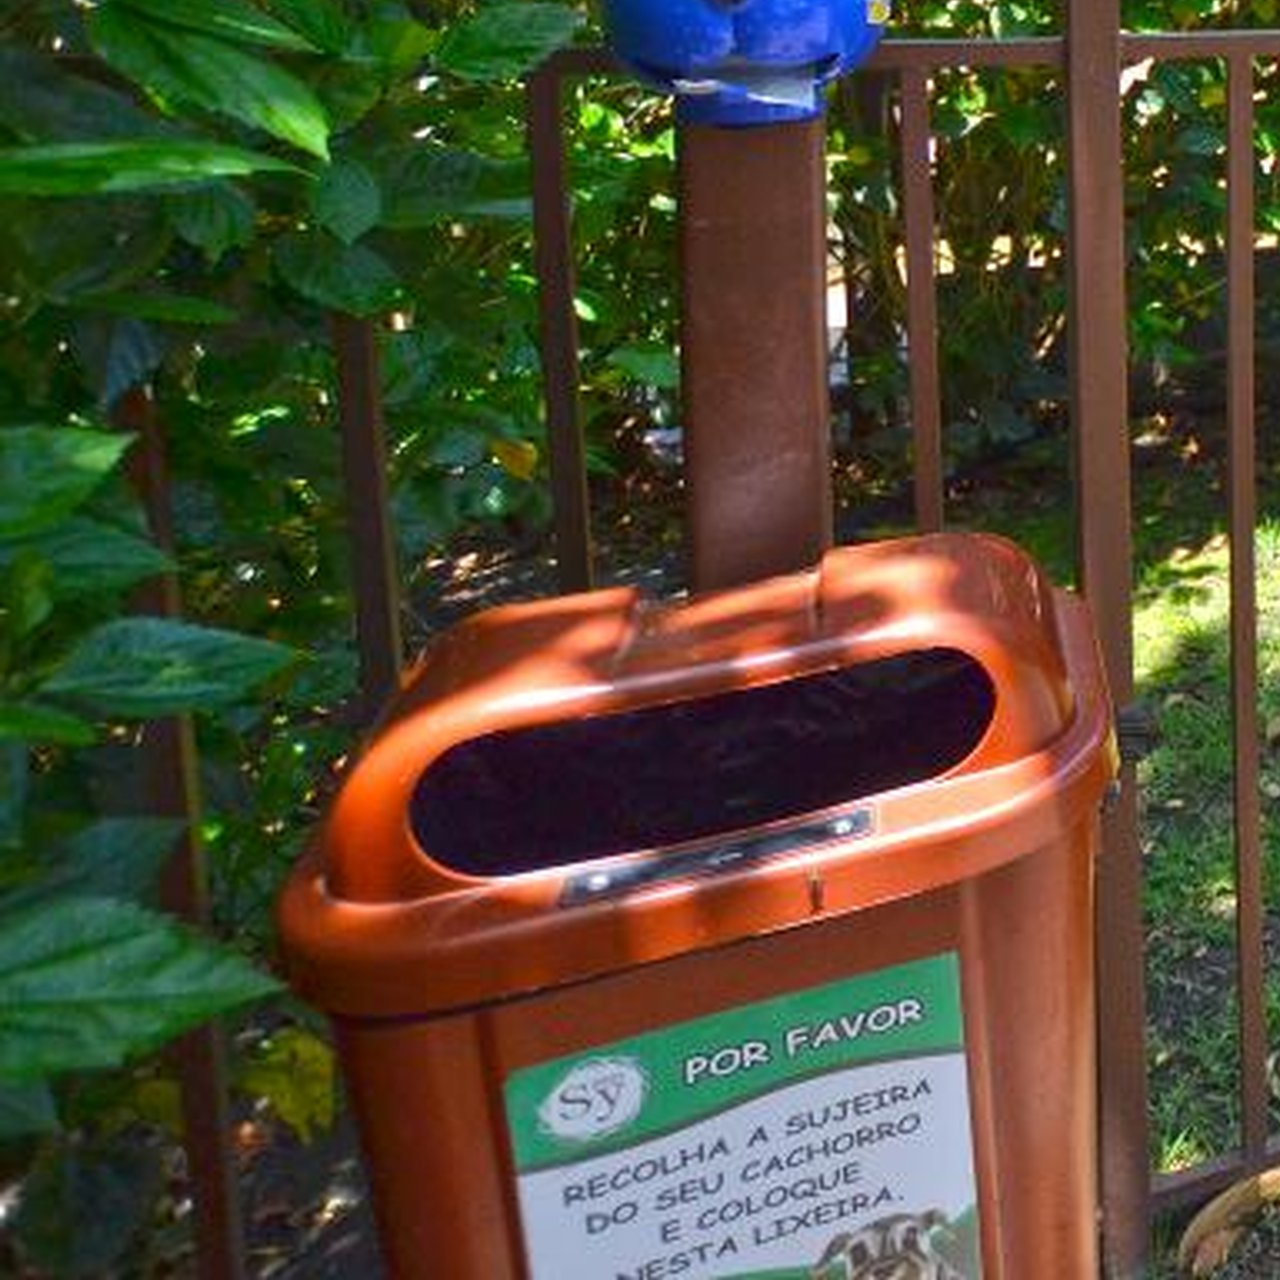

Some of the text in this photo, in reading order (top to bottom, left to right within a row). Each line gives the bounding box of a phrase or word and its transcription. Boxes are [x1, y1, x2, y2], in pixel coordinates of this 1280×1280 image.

[684, 998, 922, 1086] POR FAVOR
[562, 1079, 933, 1207] RECOLHA A SUJEIRA
[585, 1113, 921, 1235] DO SEU CACHORRO
[661, 1162, 862, 1244] E COLOQUE
[753, 1186, 904, 1245] LIXEIRA.
